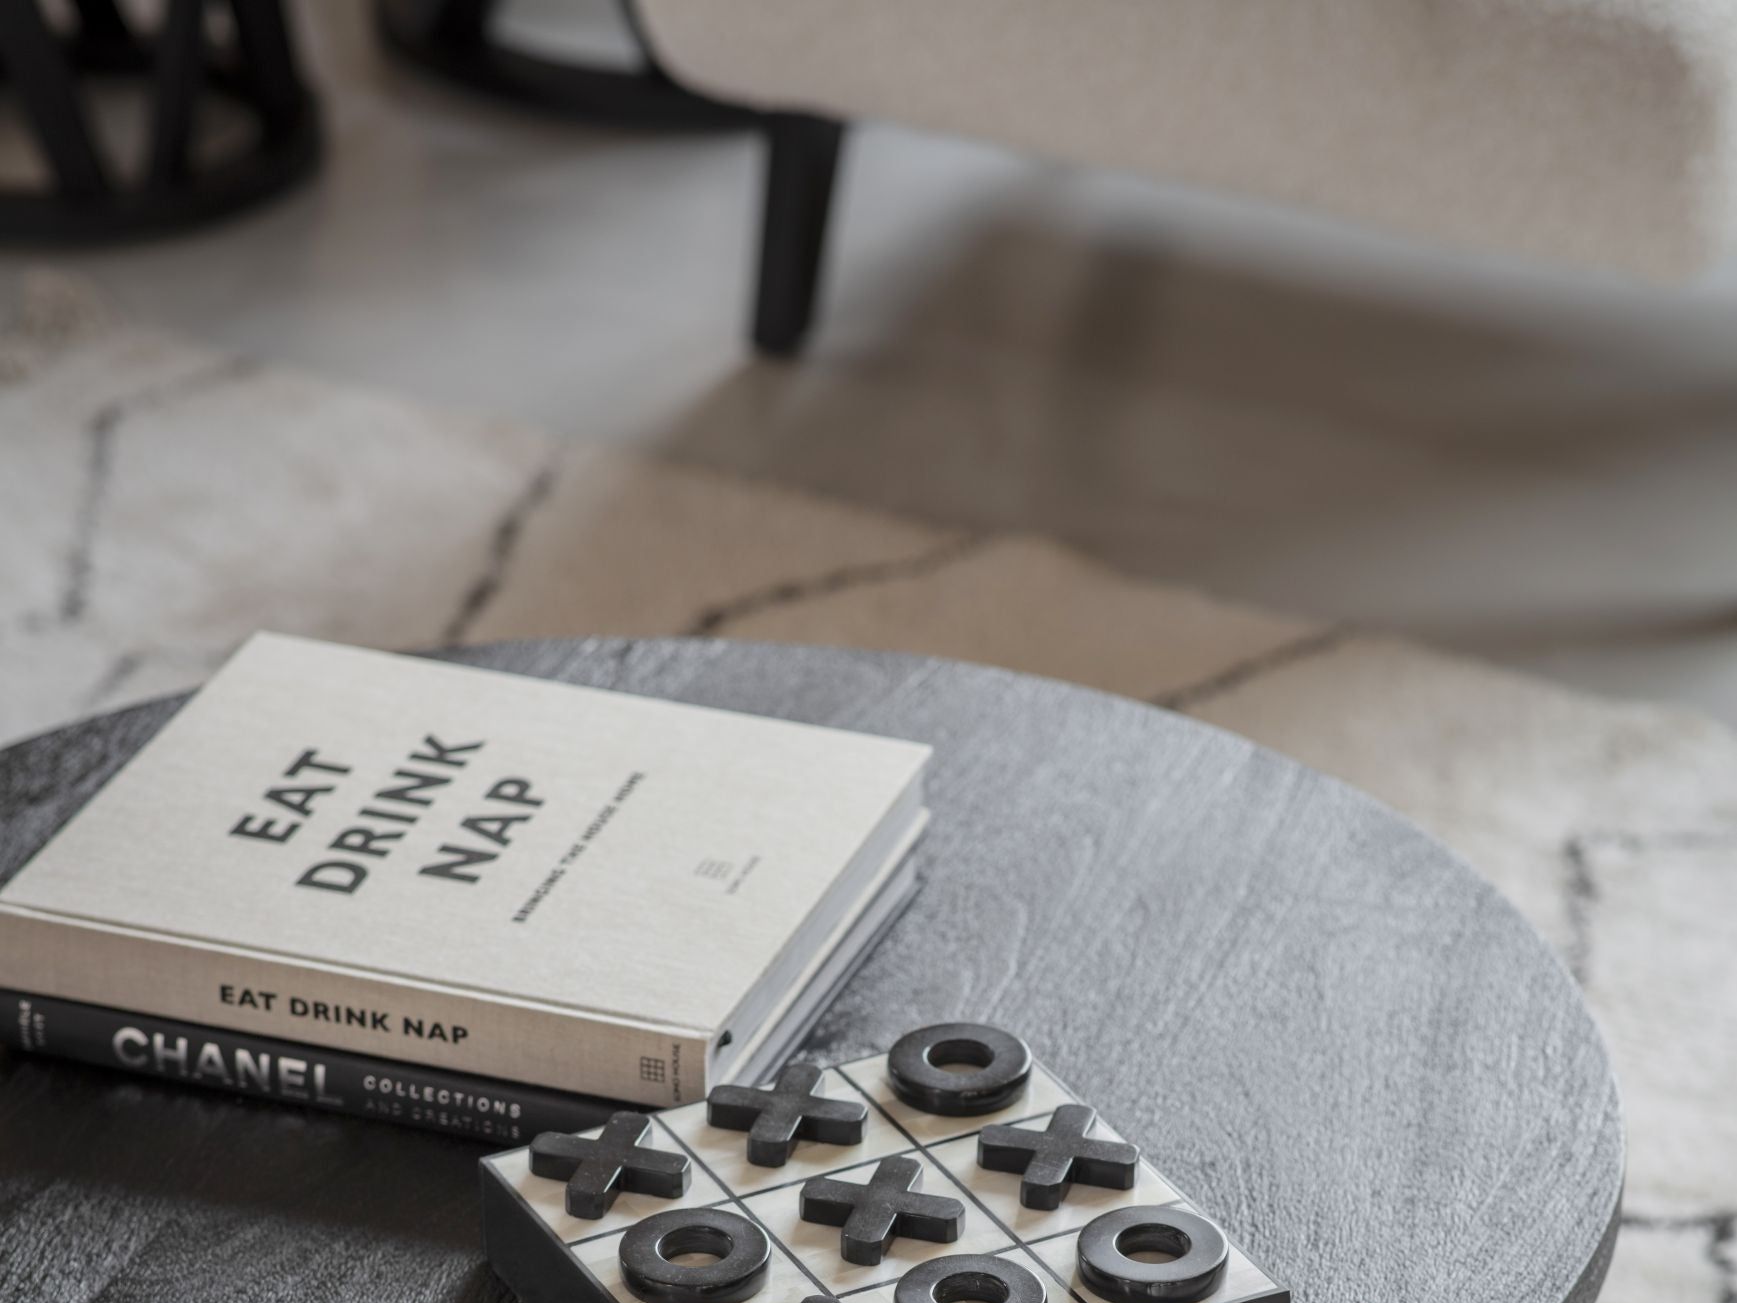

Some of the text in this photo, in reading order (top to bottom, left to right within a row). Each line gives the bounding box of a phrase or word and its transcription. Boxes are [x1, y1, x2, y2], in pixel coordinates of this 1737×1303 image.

[229, 749, 353, 844] EAT
[295, 733, 486, 894] DRINK
[418, 775, 546, 884] NAP
[559, 843, 586, 865] THE
[219, 984, 469, 1045] EAT DRINK NAP
[111, 1026, 344, 1107] CHANEL
[363, 1074, 522, 1119] COLLECTIONS
